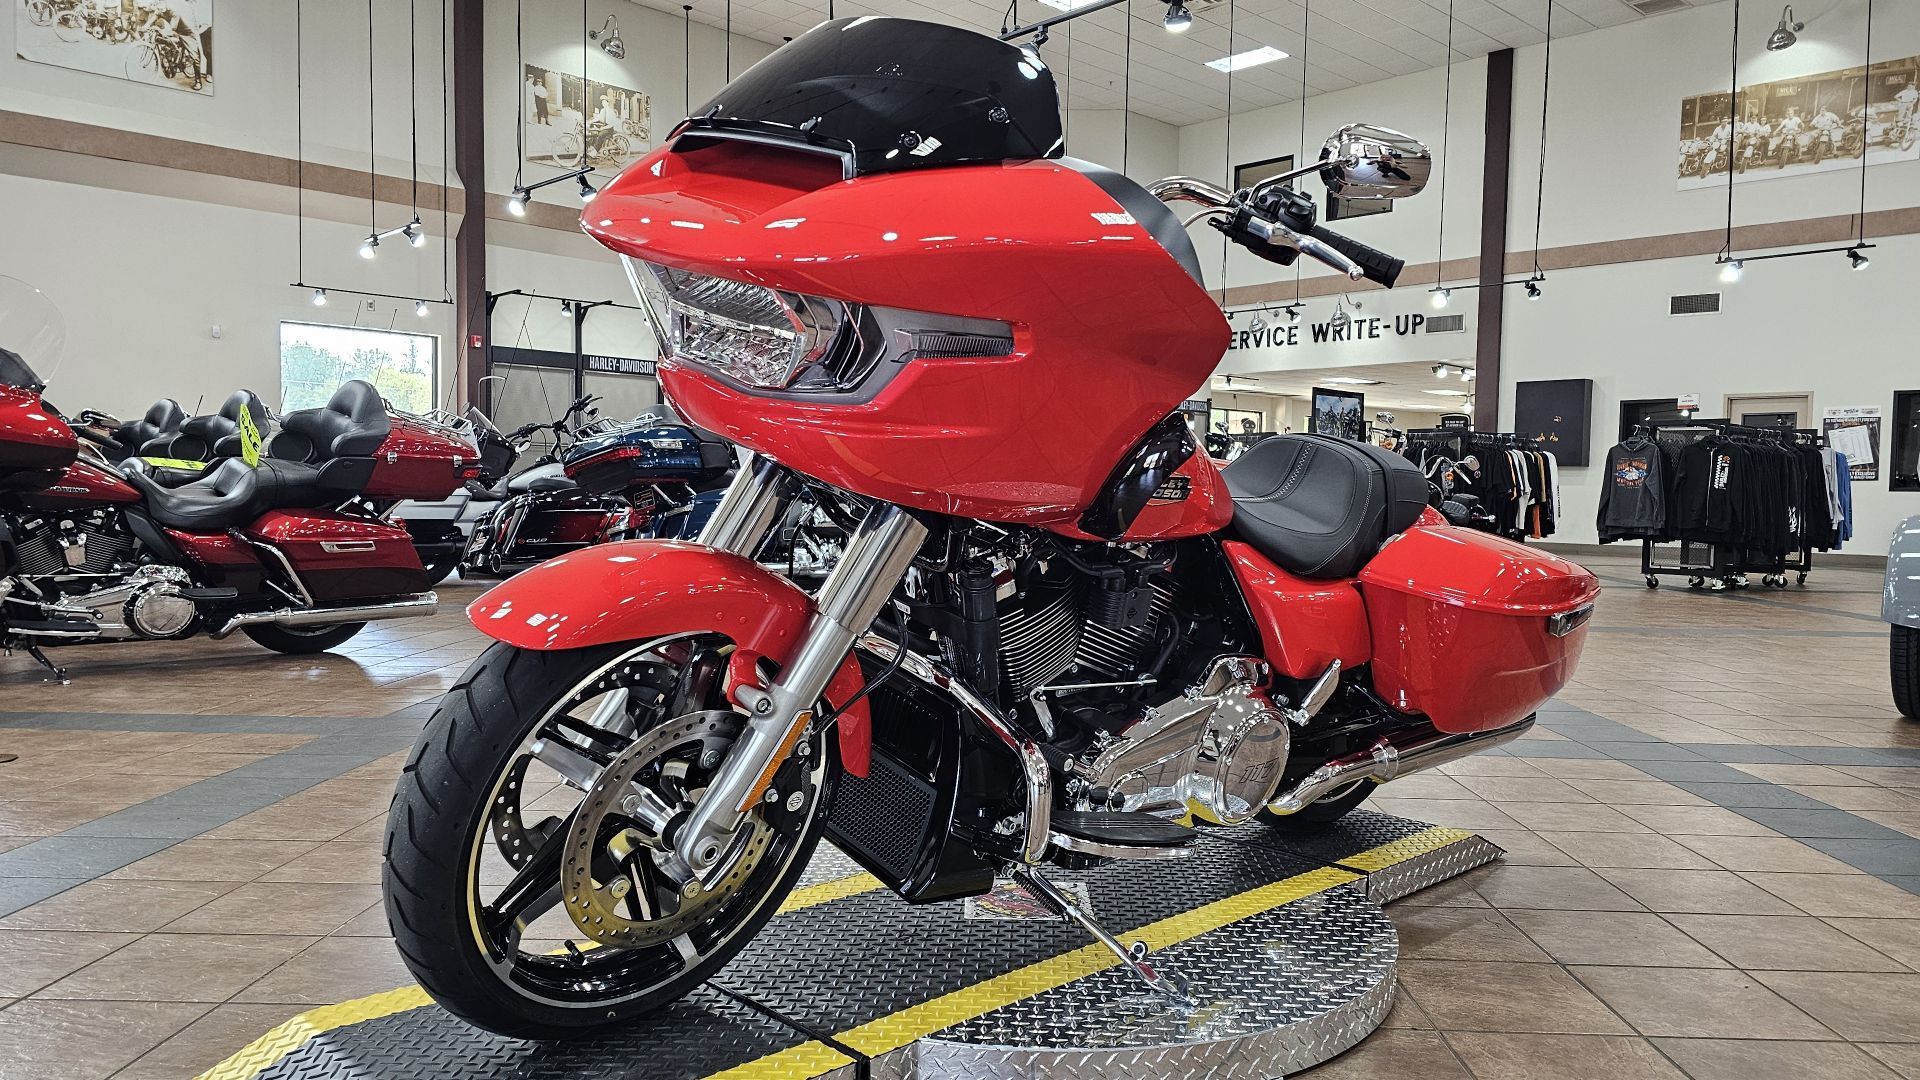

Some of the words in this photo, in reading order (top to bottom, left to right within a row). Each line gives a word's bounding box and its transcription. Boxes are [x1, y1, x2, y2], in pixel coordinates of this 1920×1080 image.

[1229, 325, 1299, 350] ERVICE
[1311, 313, 1425, 343] WRITE-UP
[589, 355, 655, 375] HARLEY-DAVIDSON
